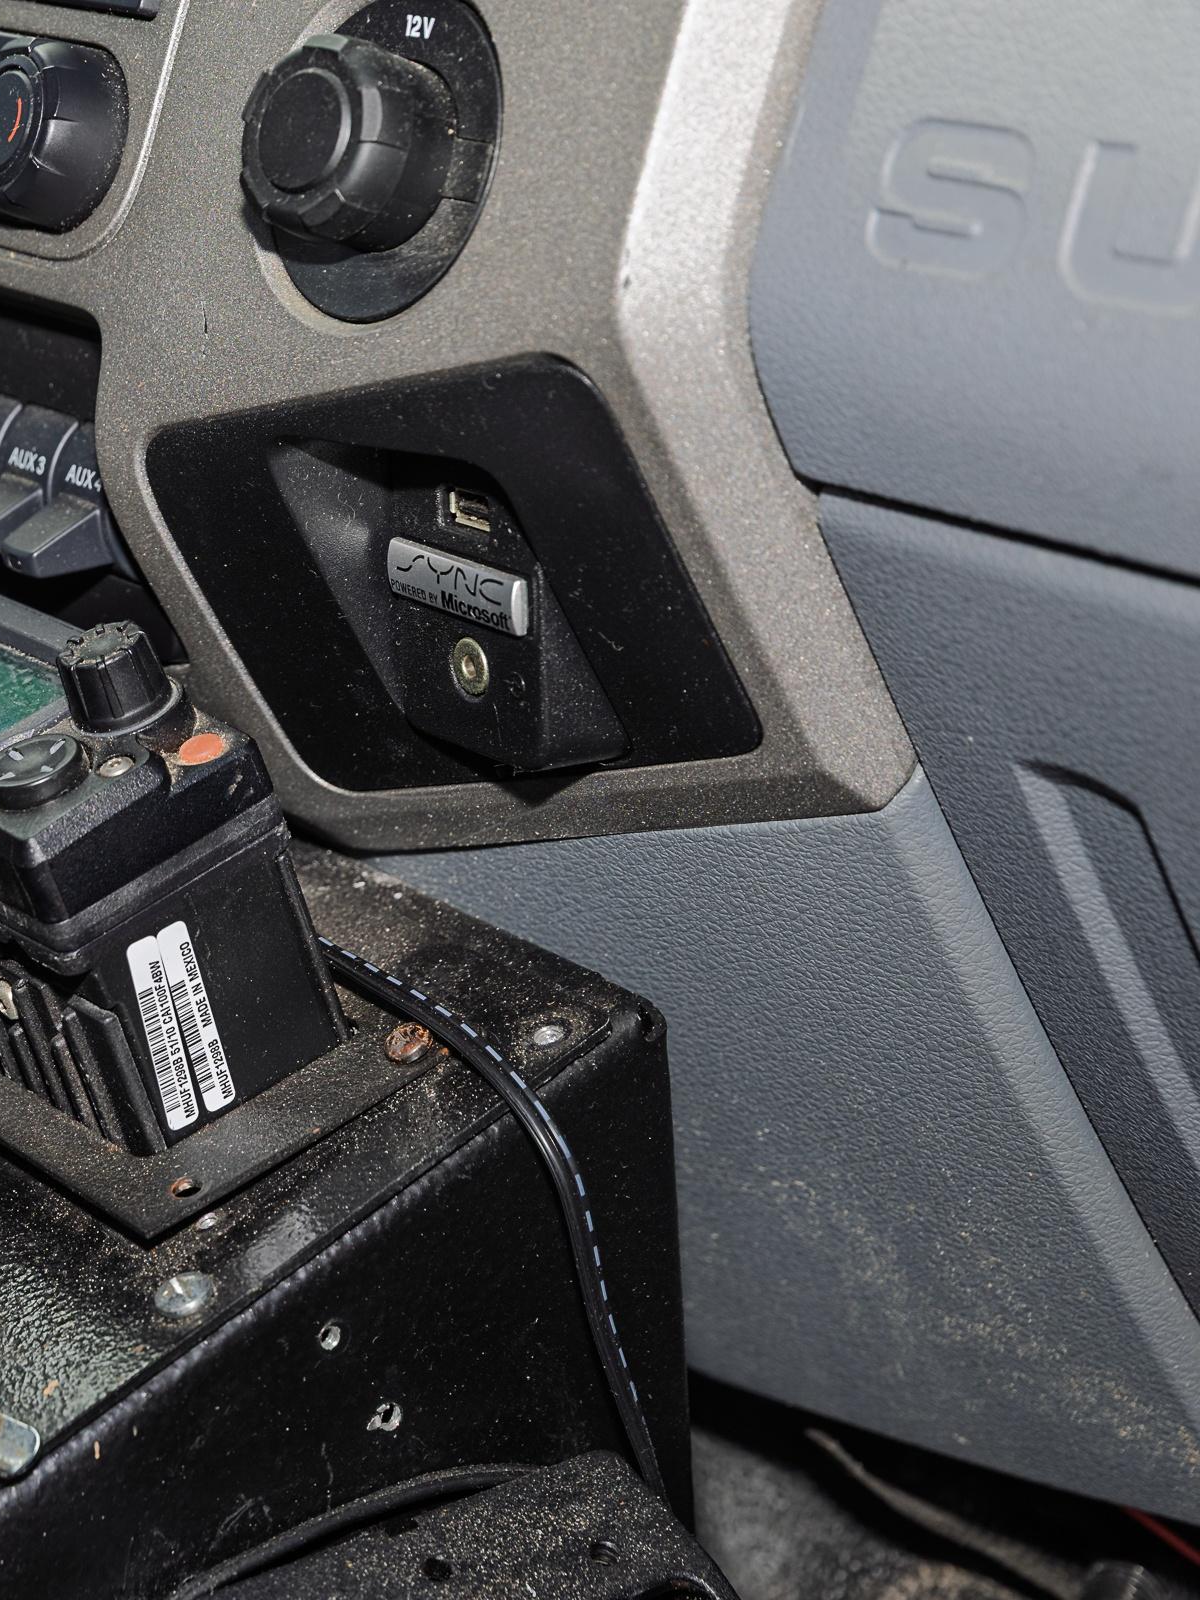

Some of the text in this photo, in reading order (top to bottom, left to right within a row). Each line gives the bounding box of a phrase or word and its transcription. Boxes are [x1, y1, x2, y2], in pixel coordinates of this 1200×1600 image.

[404, 14, 436, 39] 12V
[396, 554, 504, 606] SYNC
[390, 578, 510, 631] POWERED BY Microsoft
[179, 941, 199, 984] MEXICO
[191, 982, 202, 996] IN
[196, 995, 213, 1029] MADE
[165, 1026, 181, 1056] 51/10
